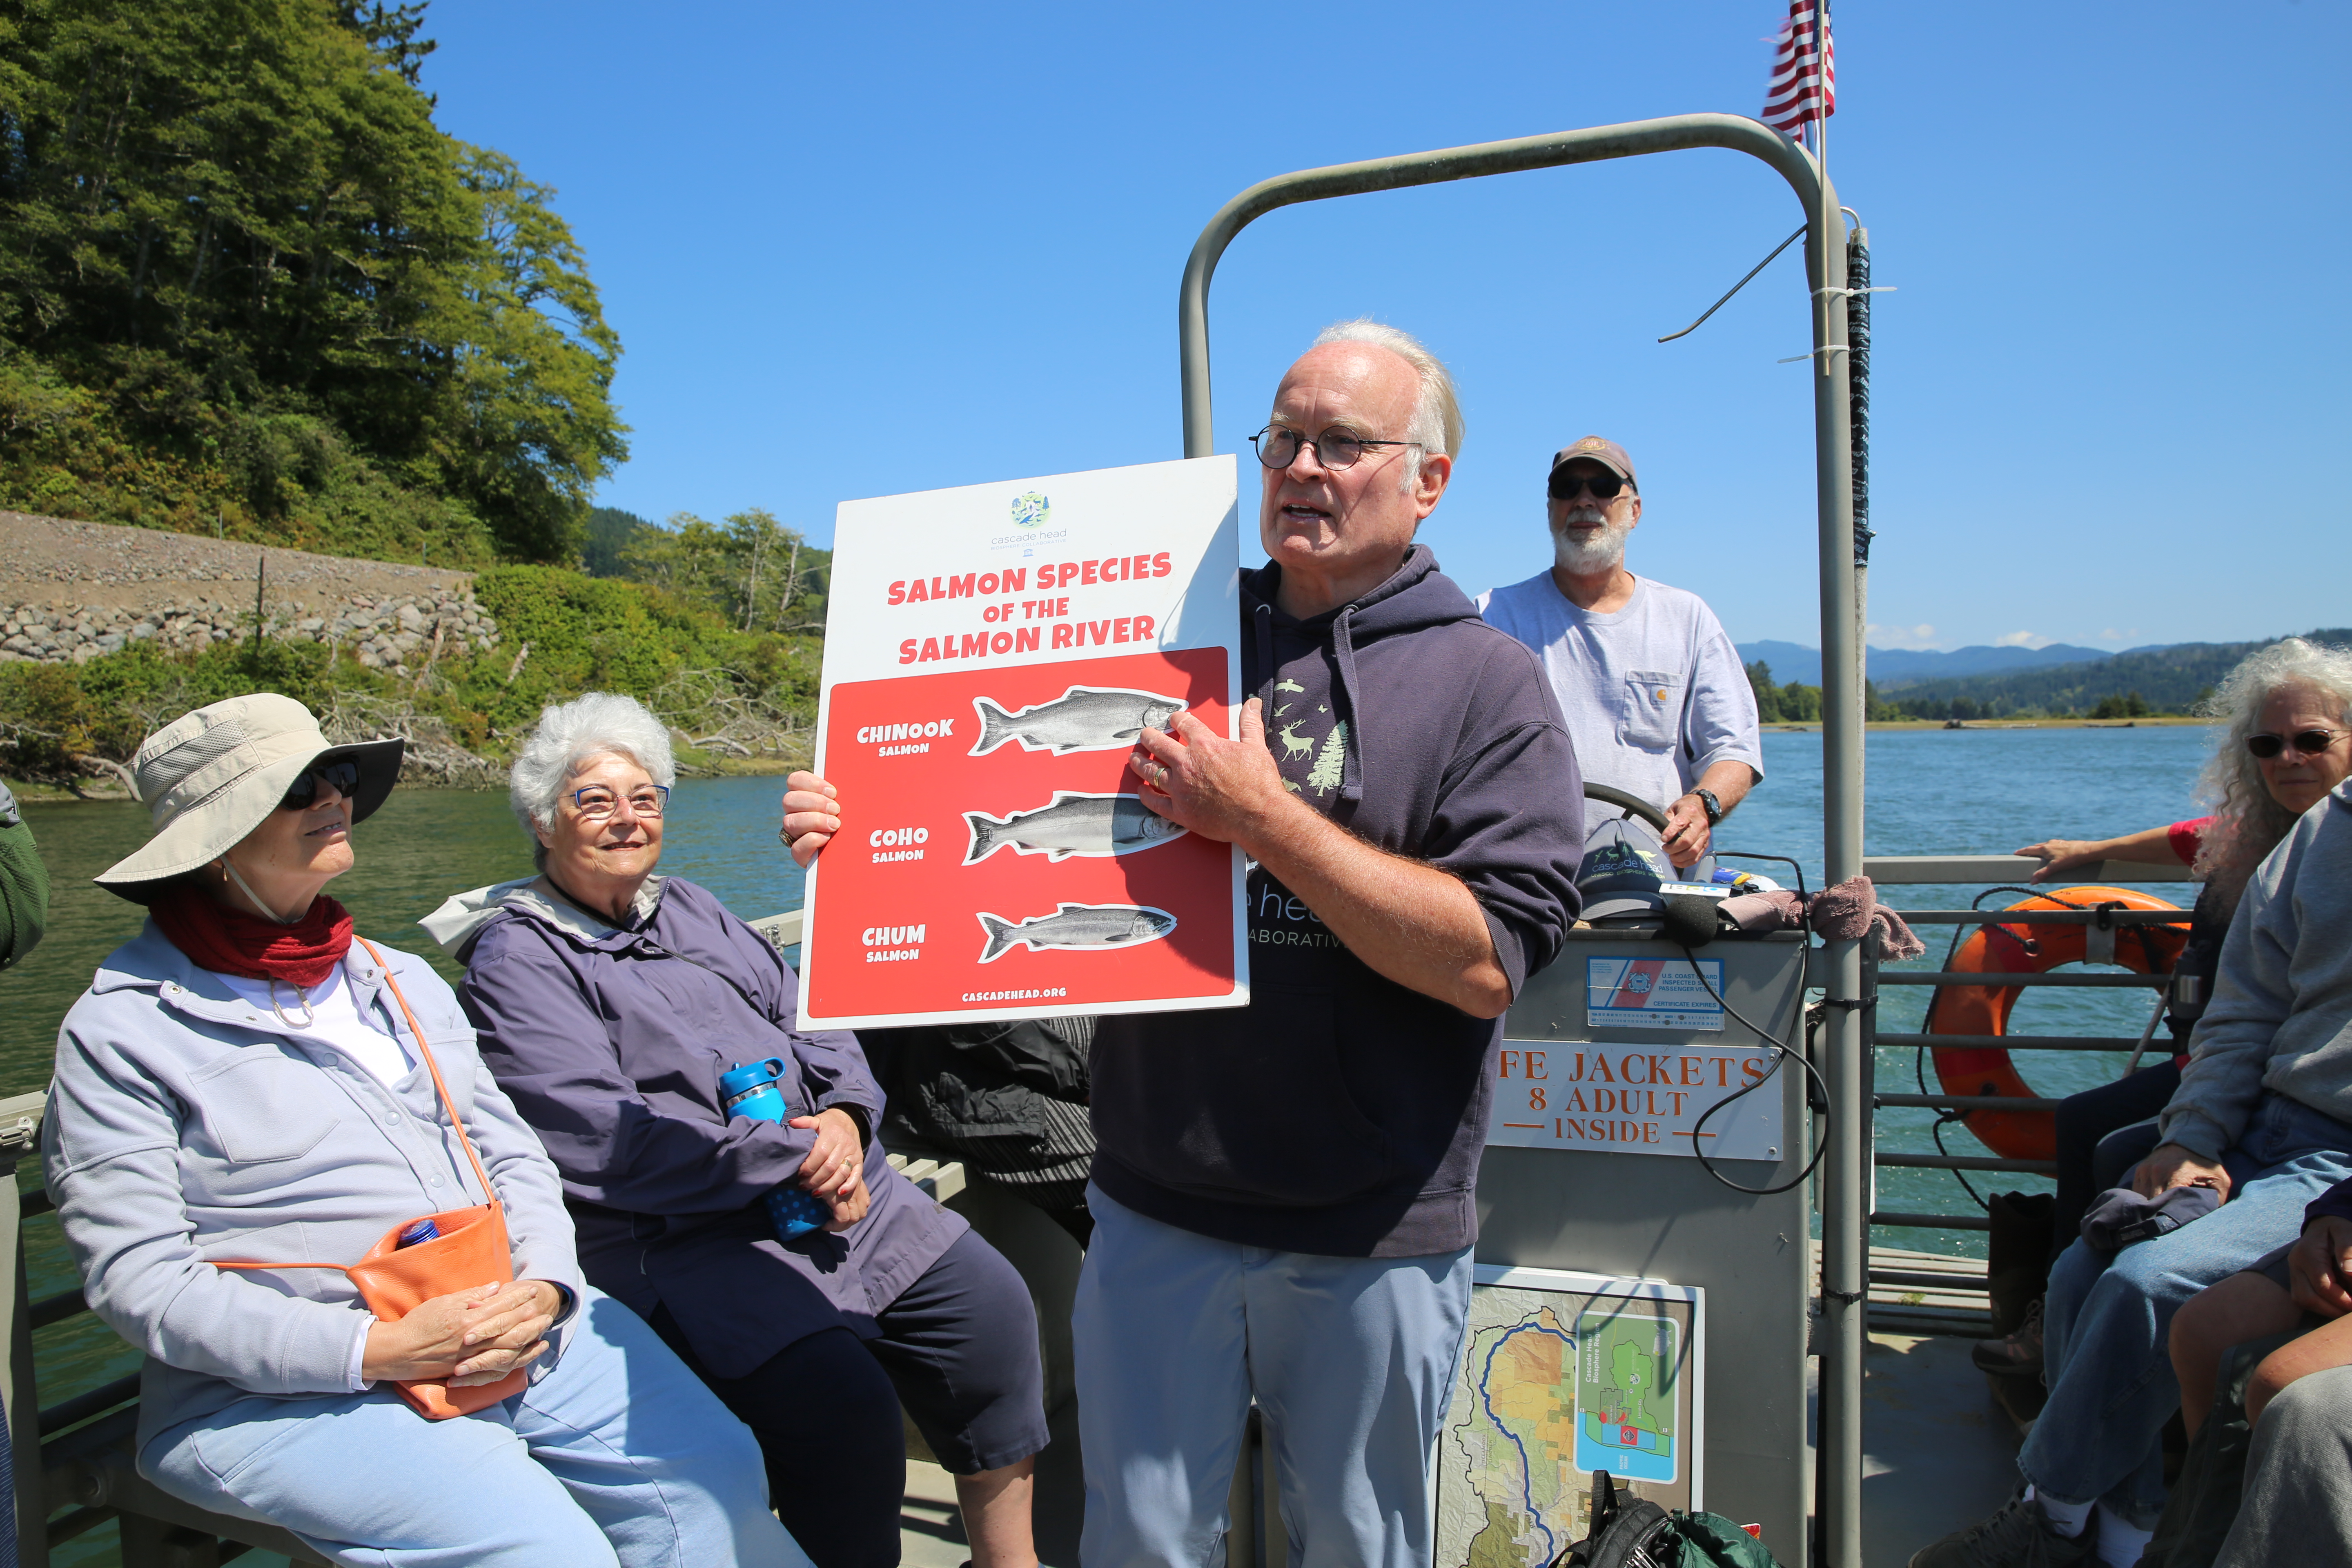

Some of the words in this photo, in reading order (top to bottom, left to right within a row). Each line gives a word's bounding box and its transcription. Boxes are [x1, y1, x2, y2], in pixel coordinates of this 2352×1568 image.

[991, 532, 1036, 544] cascade
[1040, 528, 1067, 539] head
[1022, 539, 1067, 547] COLLABORATIVE
[888, 567, 1027, 606] SALMON
[1037, 552, 1172, 590] SPECIES
[983, 603, 1015, 623] OF
[1022, 597, 1069, 619] THE
[899, 626, 1041, 665] SALMON
[1052, 615, 1155, 649] RIVER
[857, 719, 955, 744] CHINOOK
[879, 743, 929, 757] SALMON
[870, 827, 929, 847] COHO
[872, 849, 924, 863] SALMON
[1592, 858, 1638, 872] cascade
[1639, 860, 1664, 873] head
[862, 924, 926, 946] CHUM
[1248, 929, 1348, 948] ABORATIV
[866, 949, 919, 963] SALMON
[962, 987, 1066, 1002] CASCADEHEAD.ORG
[1569, 1051, 1765, 1089] JACKETS
[1529, 1087, 1547, 1111] 8
[1565, 1088, 1690, 1117] ADULT
[1555, 1119, 1662, 1143] INSIDE
